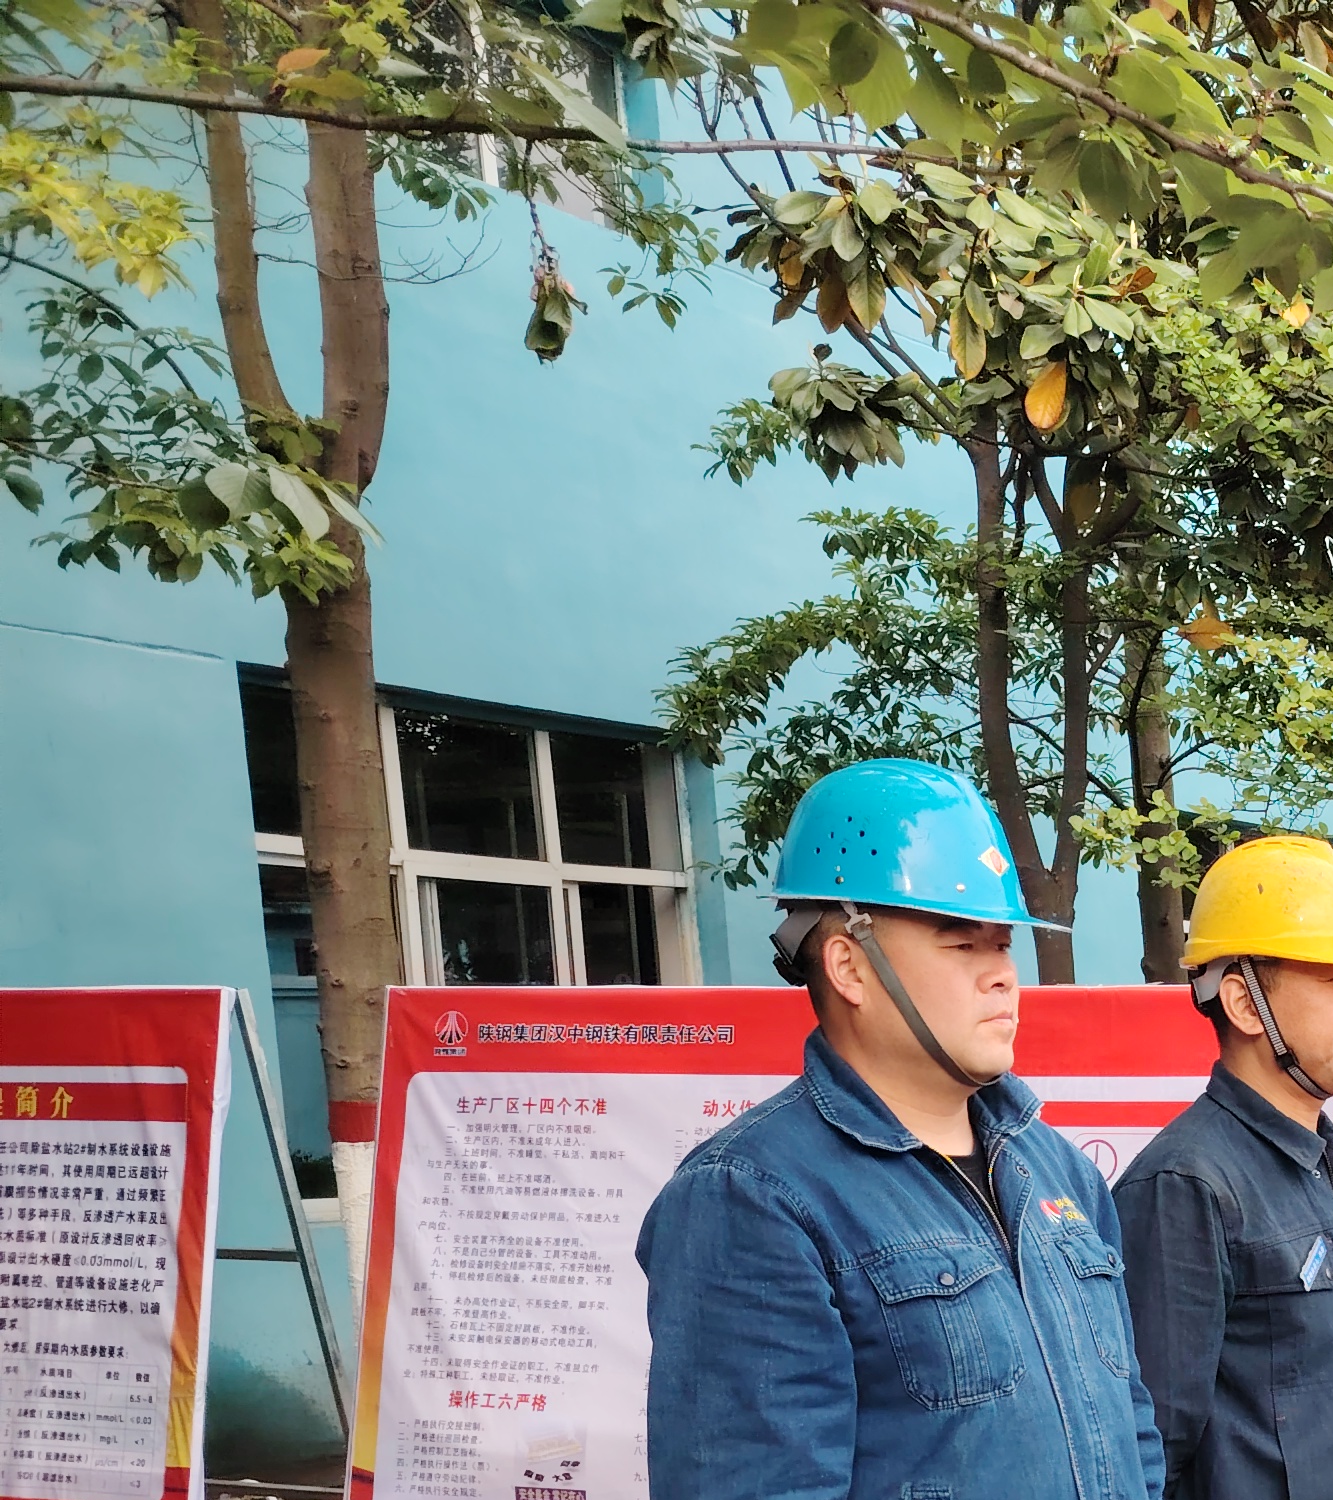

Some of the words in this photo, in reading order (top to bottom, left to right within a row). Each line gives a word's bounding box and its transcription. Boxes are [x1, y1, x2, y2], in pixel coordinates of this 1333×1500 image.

[478, 1024, 735, 1044] 陕钢集团汉中钢铁有限责任公司
[456, 1097, 608, 1116] 生产厂区十四个不准
[448, 1391, 547, 1412] 操作工六严格
